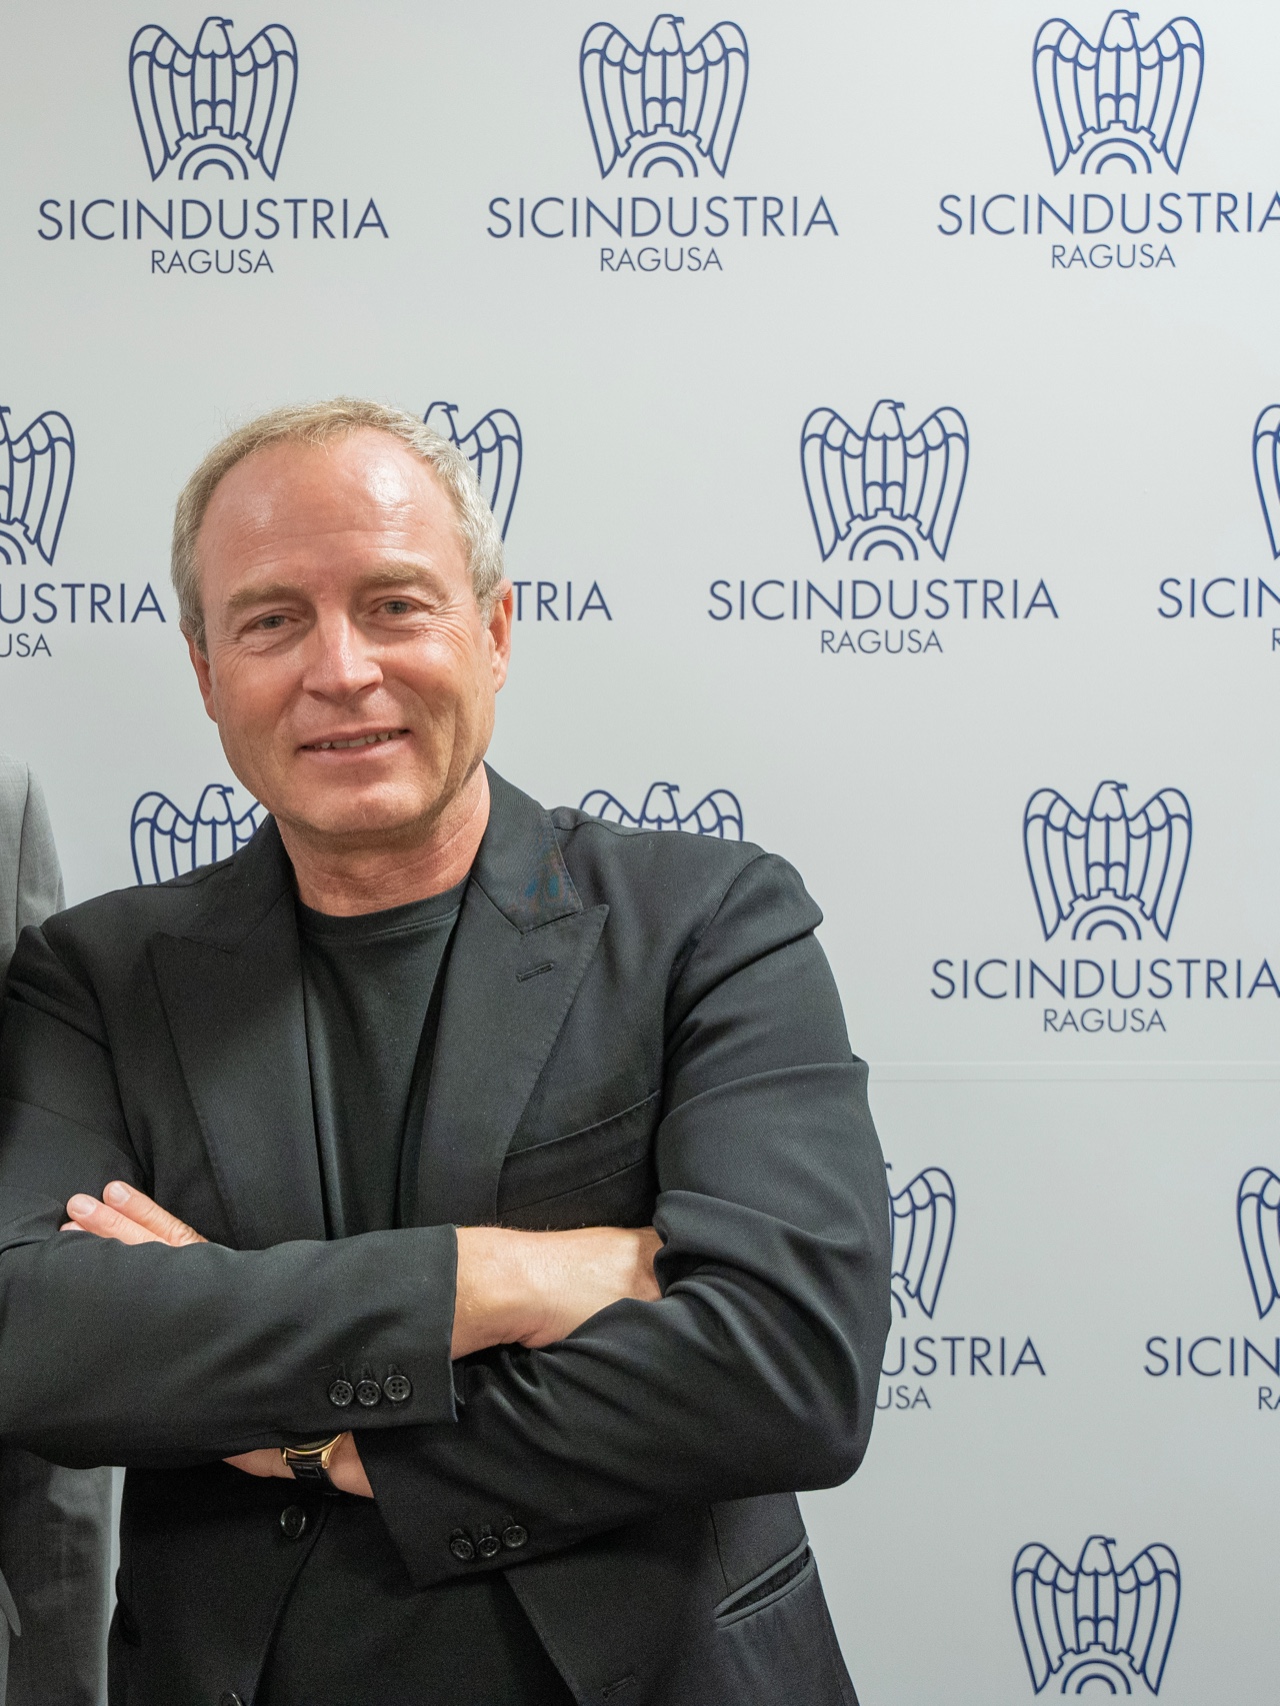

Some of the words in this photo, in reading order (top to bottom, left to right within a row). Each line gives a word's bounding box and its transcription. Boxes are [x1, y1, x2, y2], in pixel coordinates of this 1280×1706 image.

[38, 198, 389, 241] SICINDUSTRIA
[487, 196, 838, 238] SICINDUSTRIA
[152, 249, 273, 274] RAGUSA
[601, 247, 722, 271] RAGUSA
[1052, 244, 1175, 268] RAGUSA
[708, 579, 1059, 621] SICINDUSTRIA
[821, 629, 943, 654] RAGUSA
[931, 959, 1280, 999] SICINDUSTRIA
[1044, 1008, 1166, 1032] RAGUSA
